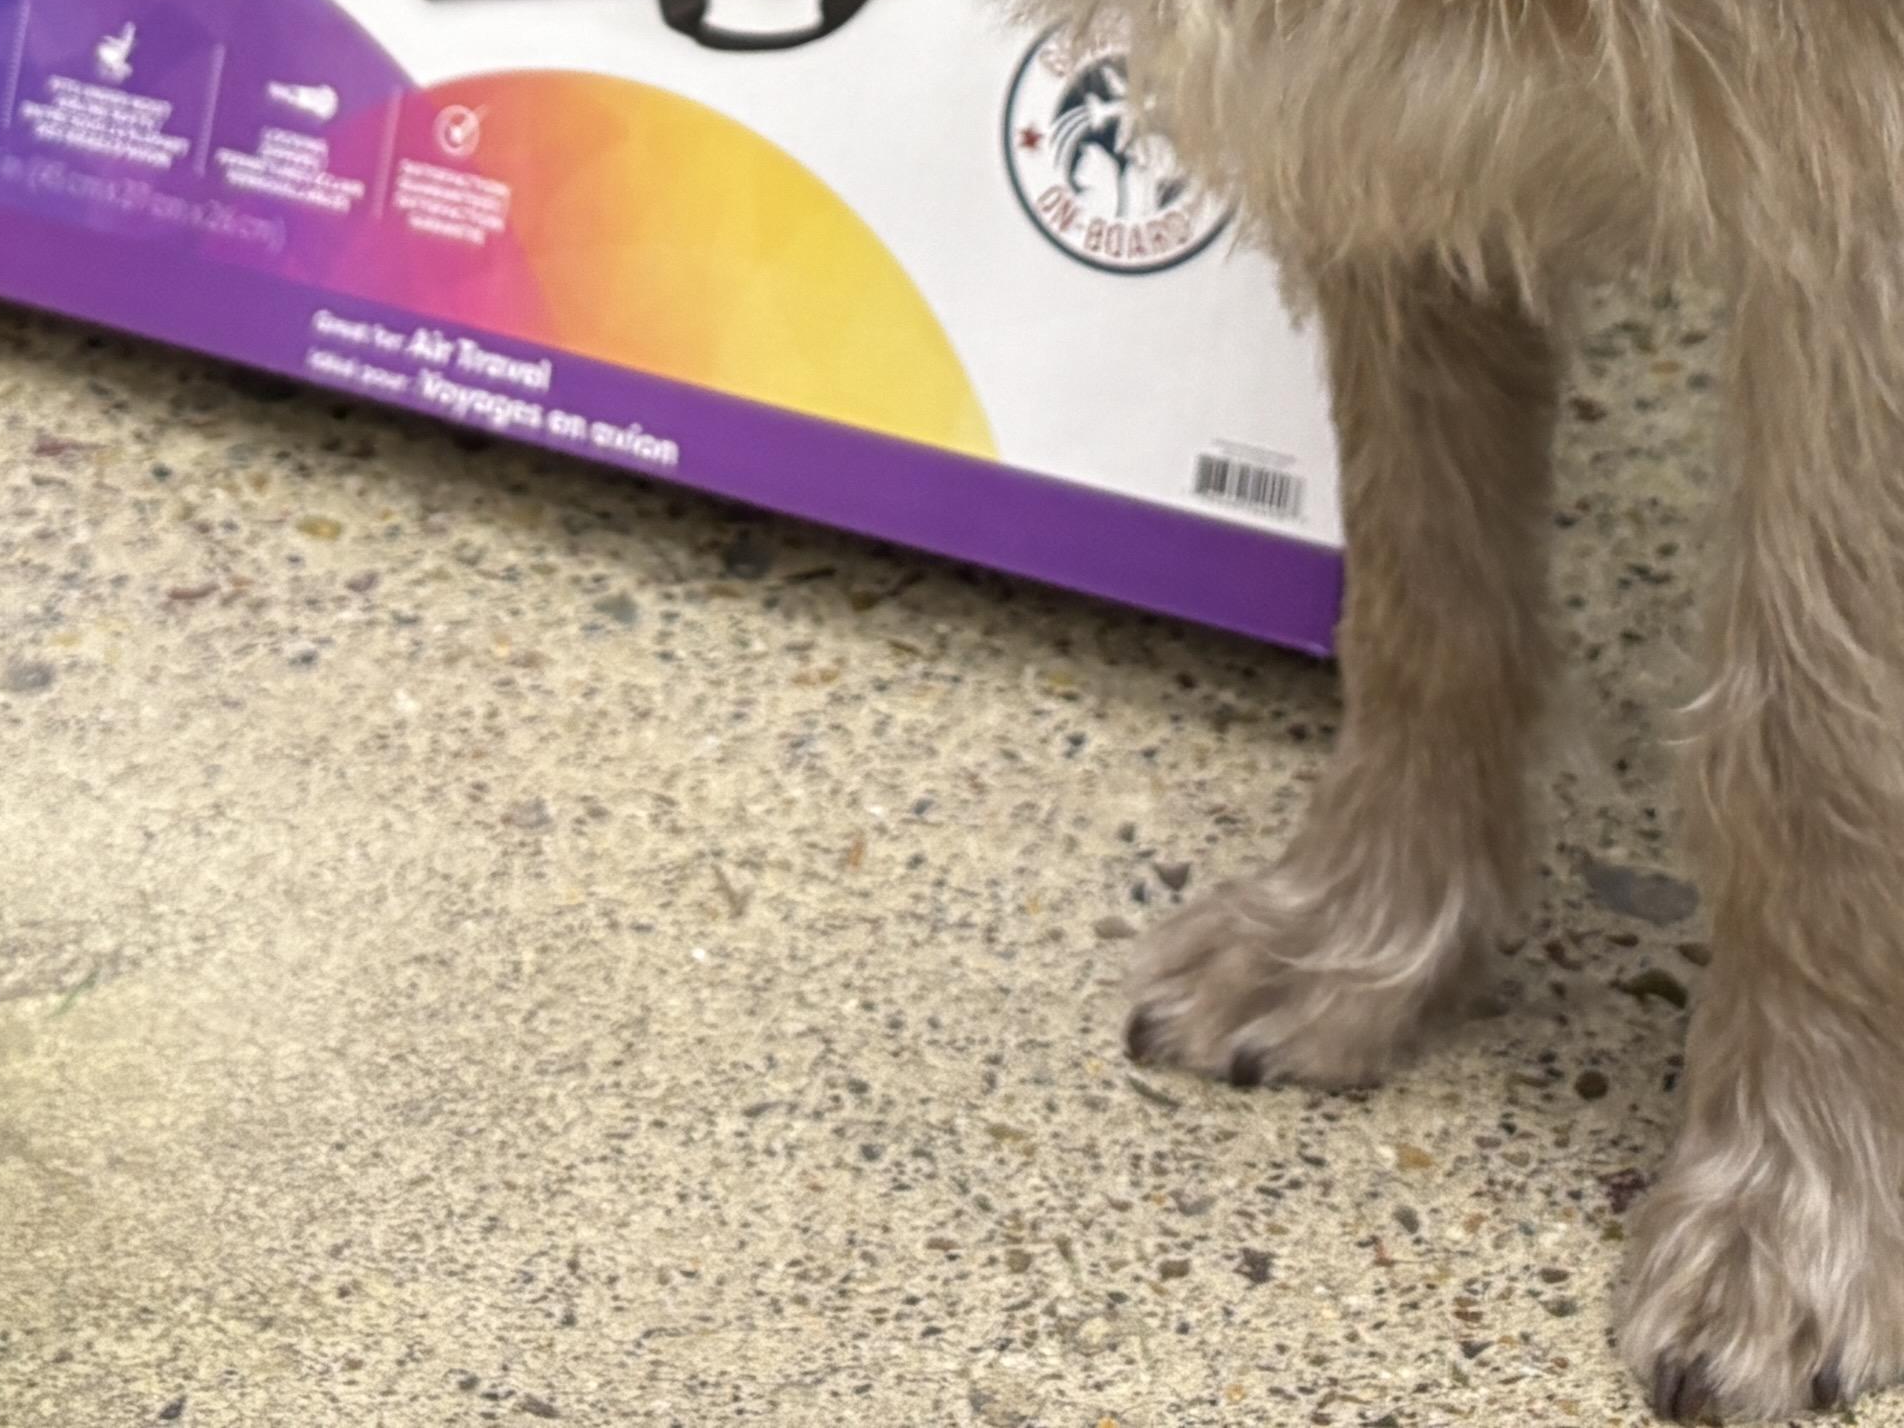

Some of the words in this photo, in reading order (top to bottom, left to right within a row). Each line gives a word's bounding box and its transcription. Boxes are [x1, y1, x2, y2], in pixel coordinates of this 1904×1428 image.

[407, 326, 454, 365] Air
[456, 337, 553, 393] Travel
[418, 368, 543, 433] Voyages
[548, 408, 586, 441] en
[590, 422, 680, 466] avion
